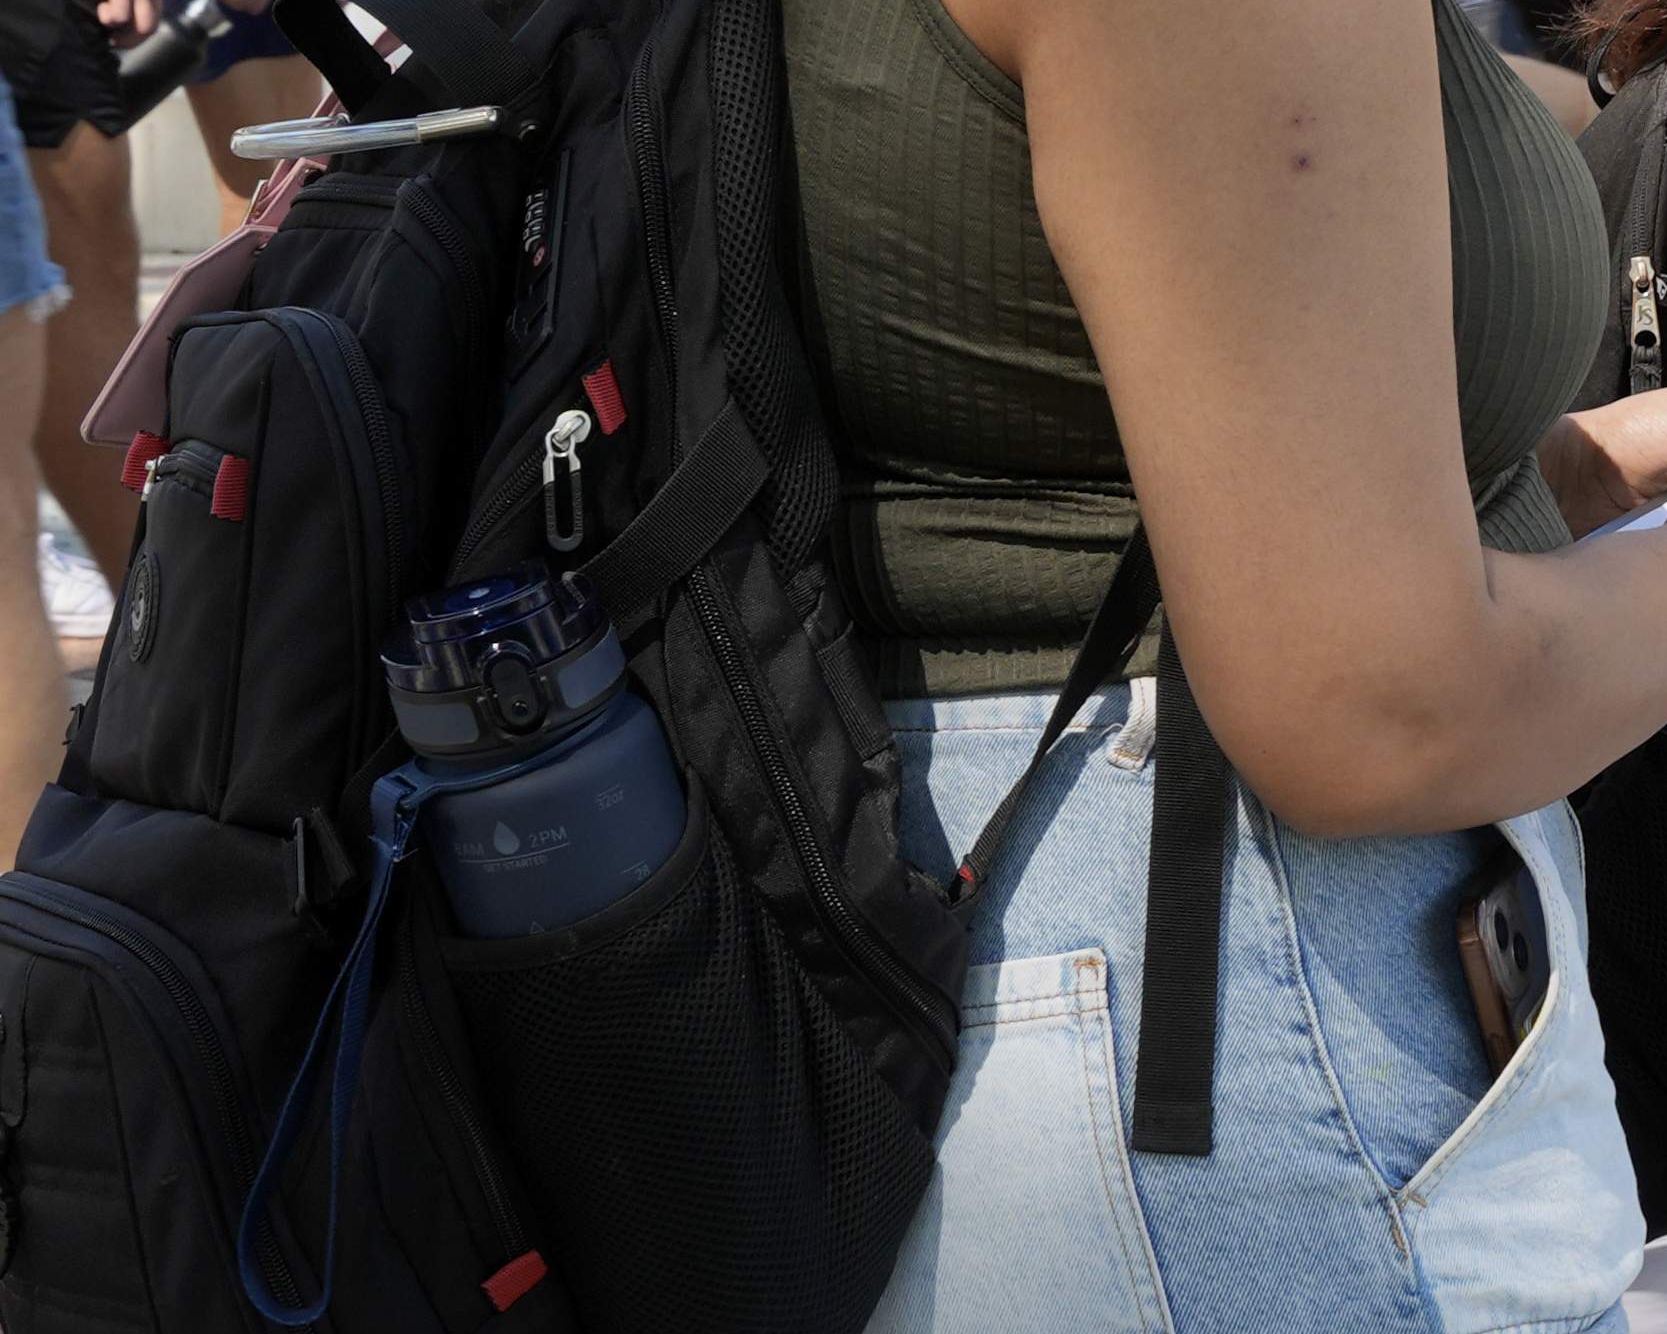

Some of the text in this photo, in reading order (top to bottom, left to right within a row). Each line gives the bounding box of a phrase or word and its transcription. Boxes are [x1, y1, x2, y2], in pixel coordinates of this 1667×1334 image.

[596, 789, 626, 811] 32oz
[527, 826, 568, 849] 2PM
[503, 853, 549, 872] STARTED
